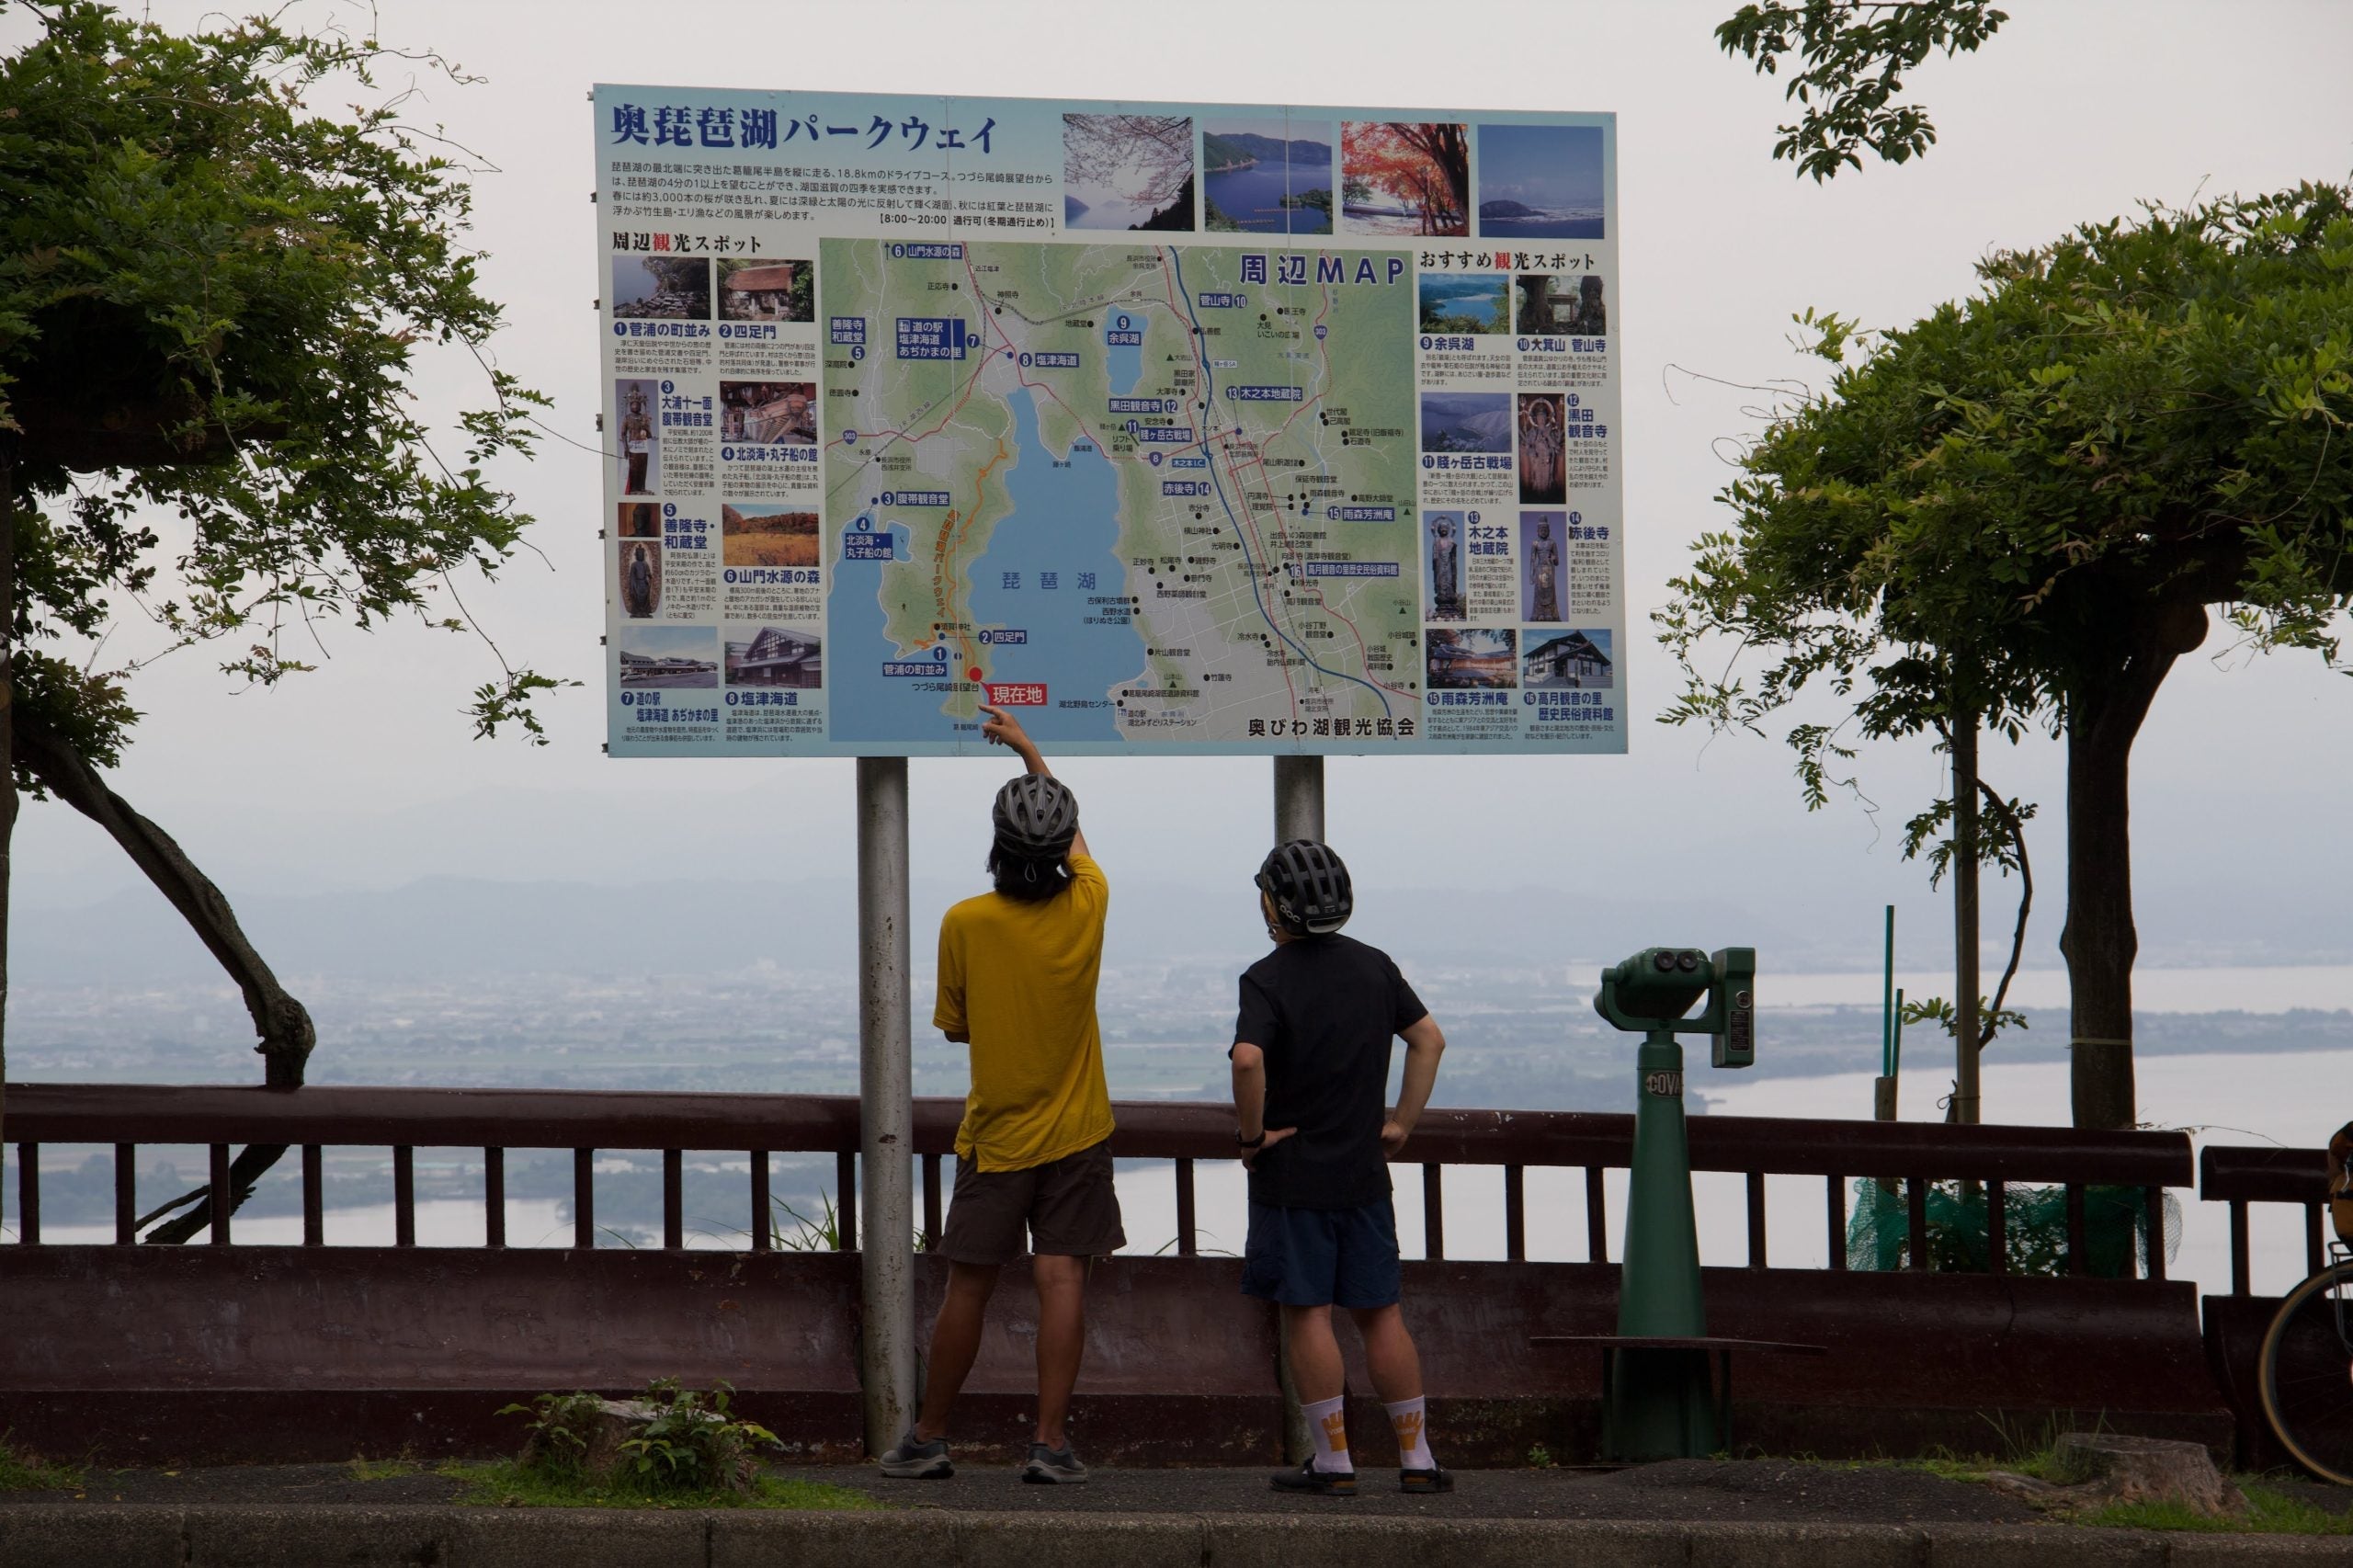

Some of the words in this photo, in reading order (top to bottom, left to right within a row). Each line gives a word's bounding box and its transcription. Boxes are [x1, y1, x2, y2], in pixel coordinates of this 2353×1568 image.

[610, 103, 997, 153] 奥琵琶湖パークウェイ
[612, 232, 761, 254] 周辺観光スポット
[908, 245, 961, 257] 山門水源の森
[1420, 251, 1596, 270] おすすめ観光スポット
[1239, 255, 1404, 285] 周辺MAP
[926, 282, 949, 291] 正応寺
[1200, 295, 1231, 306] 菅山寺
[630, 322, 710, 337] 菅浦の町並み
[734, 324, 777, 339] 四足門
[832, 320, 864, 332] 善隆寺
[913, 322, 943, 333] 道の駅
[832, 331, 864, 343] 和蔵堂
[898, 335, 940, 346] 塩津海道
[1108, 333, 1140, 345] 余呉湖
[1256, 331, 1300, 339] いこいの広場
[1434, 336, 1474, 351] 余呉湖
[1531, 338, 1565, 352] 大箕山
[1572, 338, 1607, 352] 菅山寺
[899, 347, 962, 358] あぢかまの里
[1036, 355, 1077, 366] 塩津海道
[1241, 389, 1302, 399] 木之本地蔵院
[662, 396, 712, 411] 大浦十一面
[1109, 401, 1161, 412] 黒田観音寺
[662, 412, 712, 427] 腹帯観音堂
[1568, 409, 1594, 423] 黒田
[844, 432, 856, 440] 303
[1568, 425, 1608, 438] 観音寺
[736, 447, 818, 462] 北淡海・丸子船の館
[1112, 443, 1133, 452] 乗り場
[1164, 483, 1195, 494] 赤後寺
[897, 494, 949, 505] 腹帯観音堂
[1343, 508, 1393, 520] 雨森芳洲庵
[1469, 526, 1508, 540] 木之本
[1569, 526, 1609, 540] 赤後寺
[664, 535, 708, 550] 和蔵堂
[1469, 541, 1508, 555] 地蔵院
[846, 548, 892, 559] 丸子船の館
[1307, 563, 1398, 575] 高月観音の里歴史民俗資料館
[739, 570, 821, 584] 山門水源の森
[1002, 572, 1096, 591] 琵琶湖
[994, 631, 1026, 642] 四足門
[883, 665, 946, 676] 菅浦の町並み
[637, 691, 660, 706] 道の駅
[741, 691, 798, 706] 塩津海道
[993, 687, 1042, 704] 現在地
[1441, 691, 1508, 706] 雨森芳洲庵
[1538, 692, 1602, 706] 高月観音の里
[636, 708, 669, 722] 塩津海道
[672, 708, 719, 722] あぢかまの里
[1539, 707, 1613, 722] 歴史民俗資料館
[1248, 718, 1415, 736] 奥びわ湖観光協会
